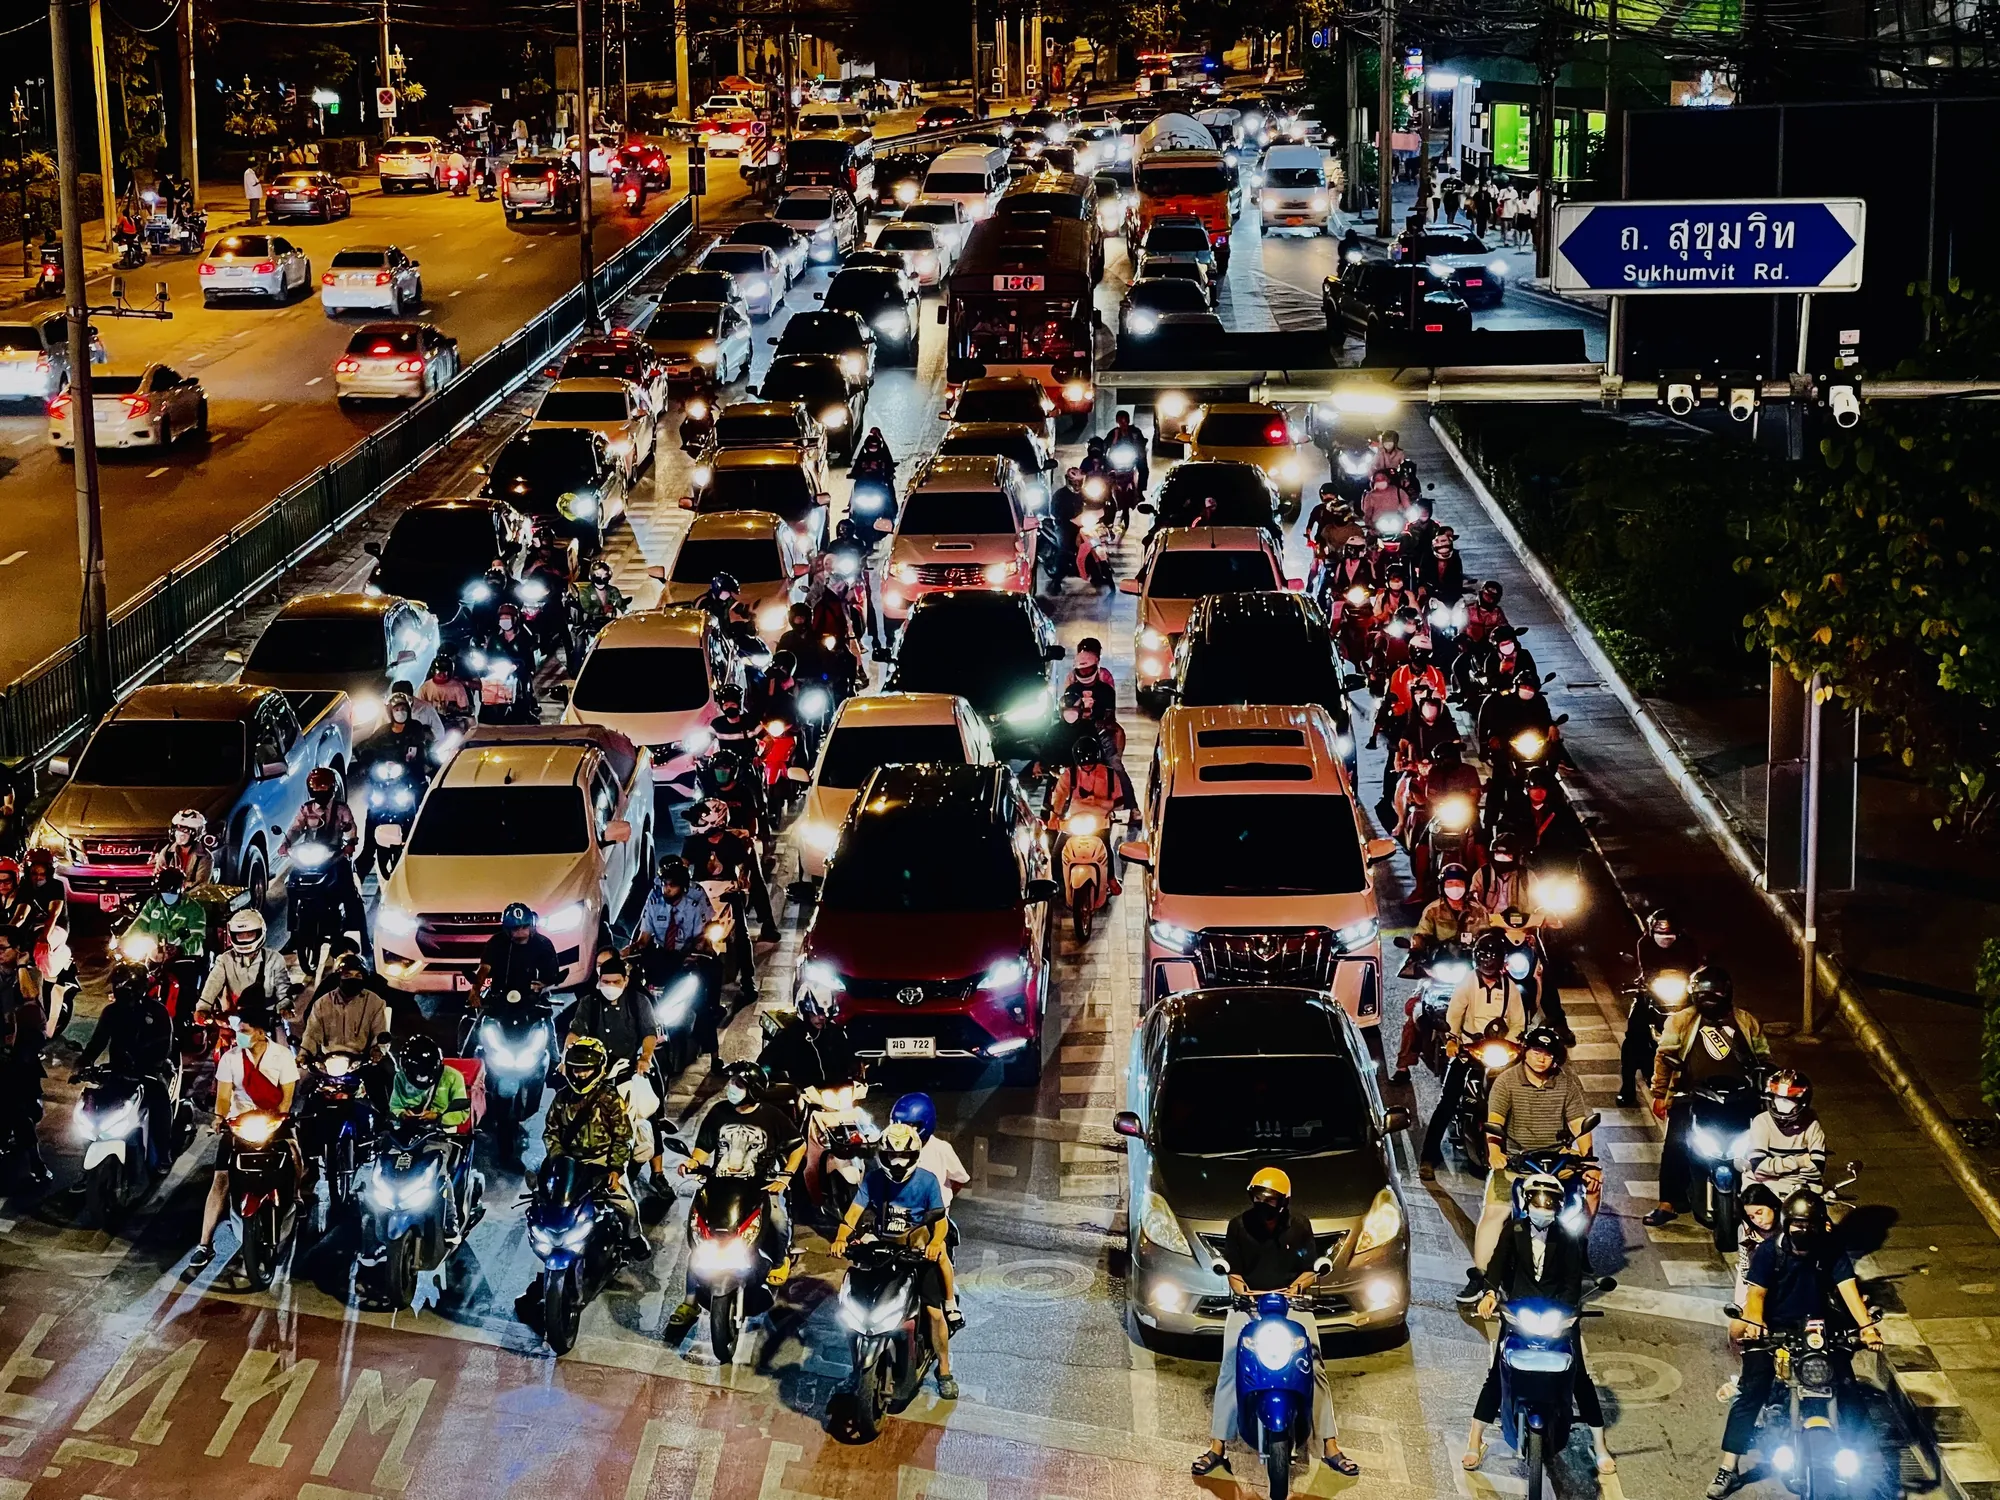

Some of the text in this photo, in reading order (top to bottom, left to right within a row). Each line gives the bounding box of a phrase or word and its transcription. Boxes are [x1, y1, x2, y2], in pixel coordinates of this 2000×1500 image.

[1621, 212, 1795, 261] ถ. สุขุมวิท
[1623, 263, 1789, 282] Sukhumvit Rd.
[913, 1040, 929, 1049] 722
[1706, 1030, 1728, 1049] RBT
